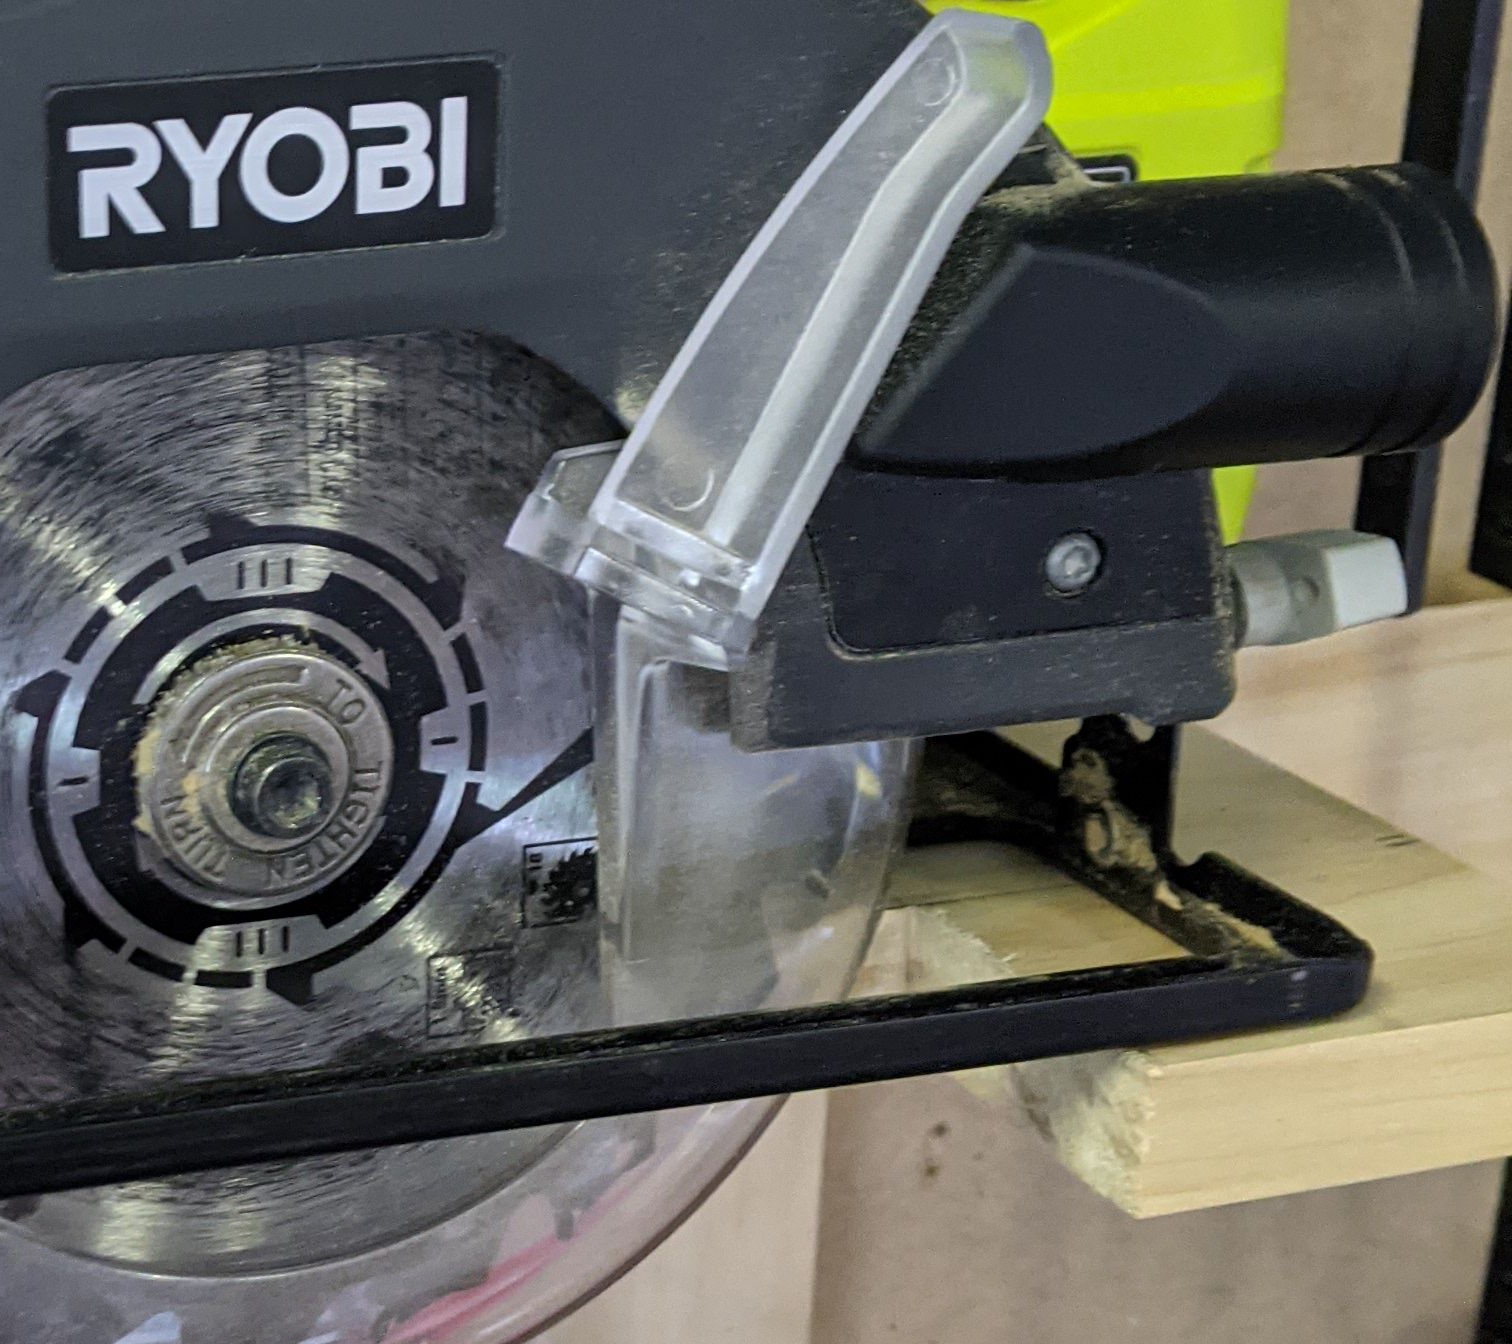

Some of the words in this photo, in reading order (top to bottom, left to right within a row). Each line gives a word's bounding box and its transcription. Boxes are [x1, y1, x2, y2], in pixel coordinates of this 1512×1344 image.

[66, 96, 468, 239] RYOBI
[326, 677, 368, 726] TO
[264, 759, 385, 891] TIGHTEN
